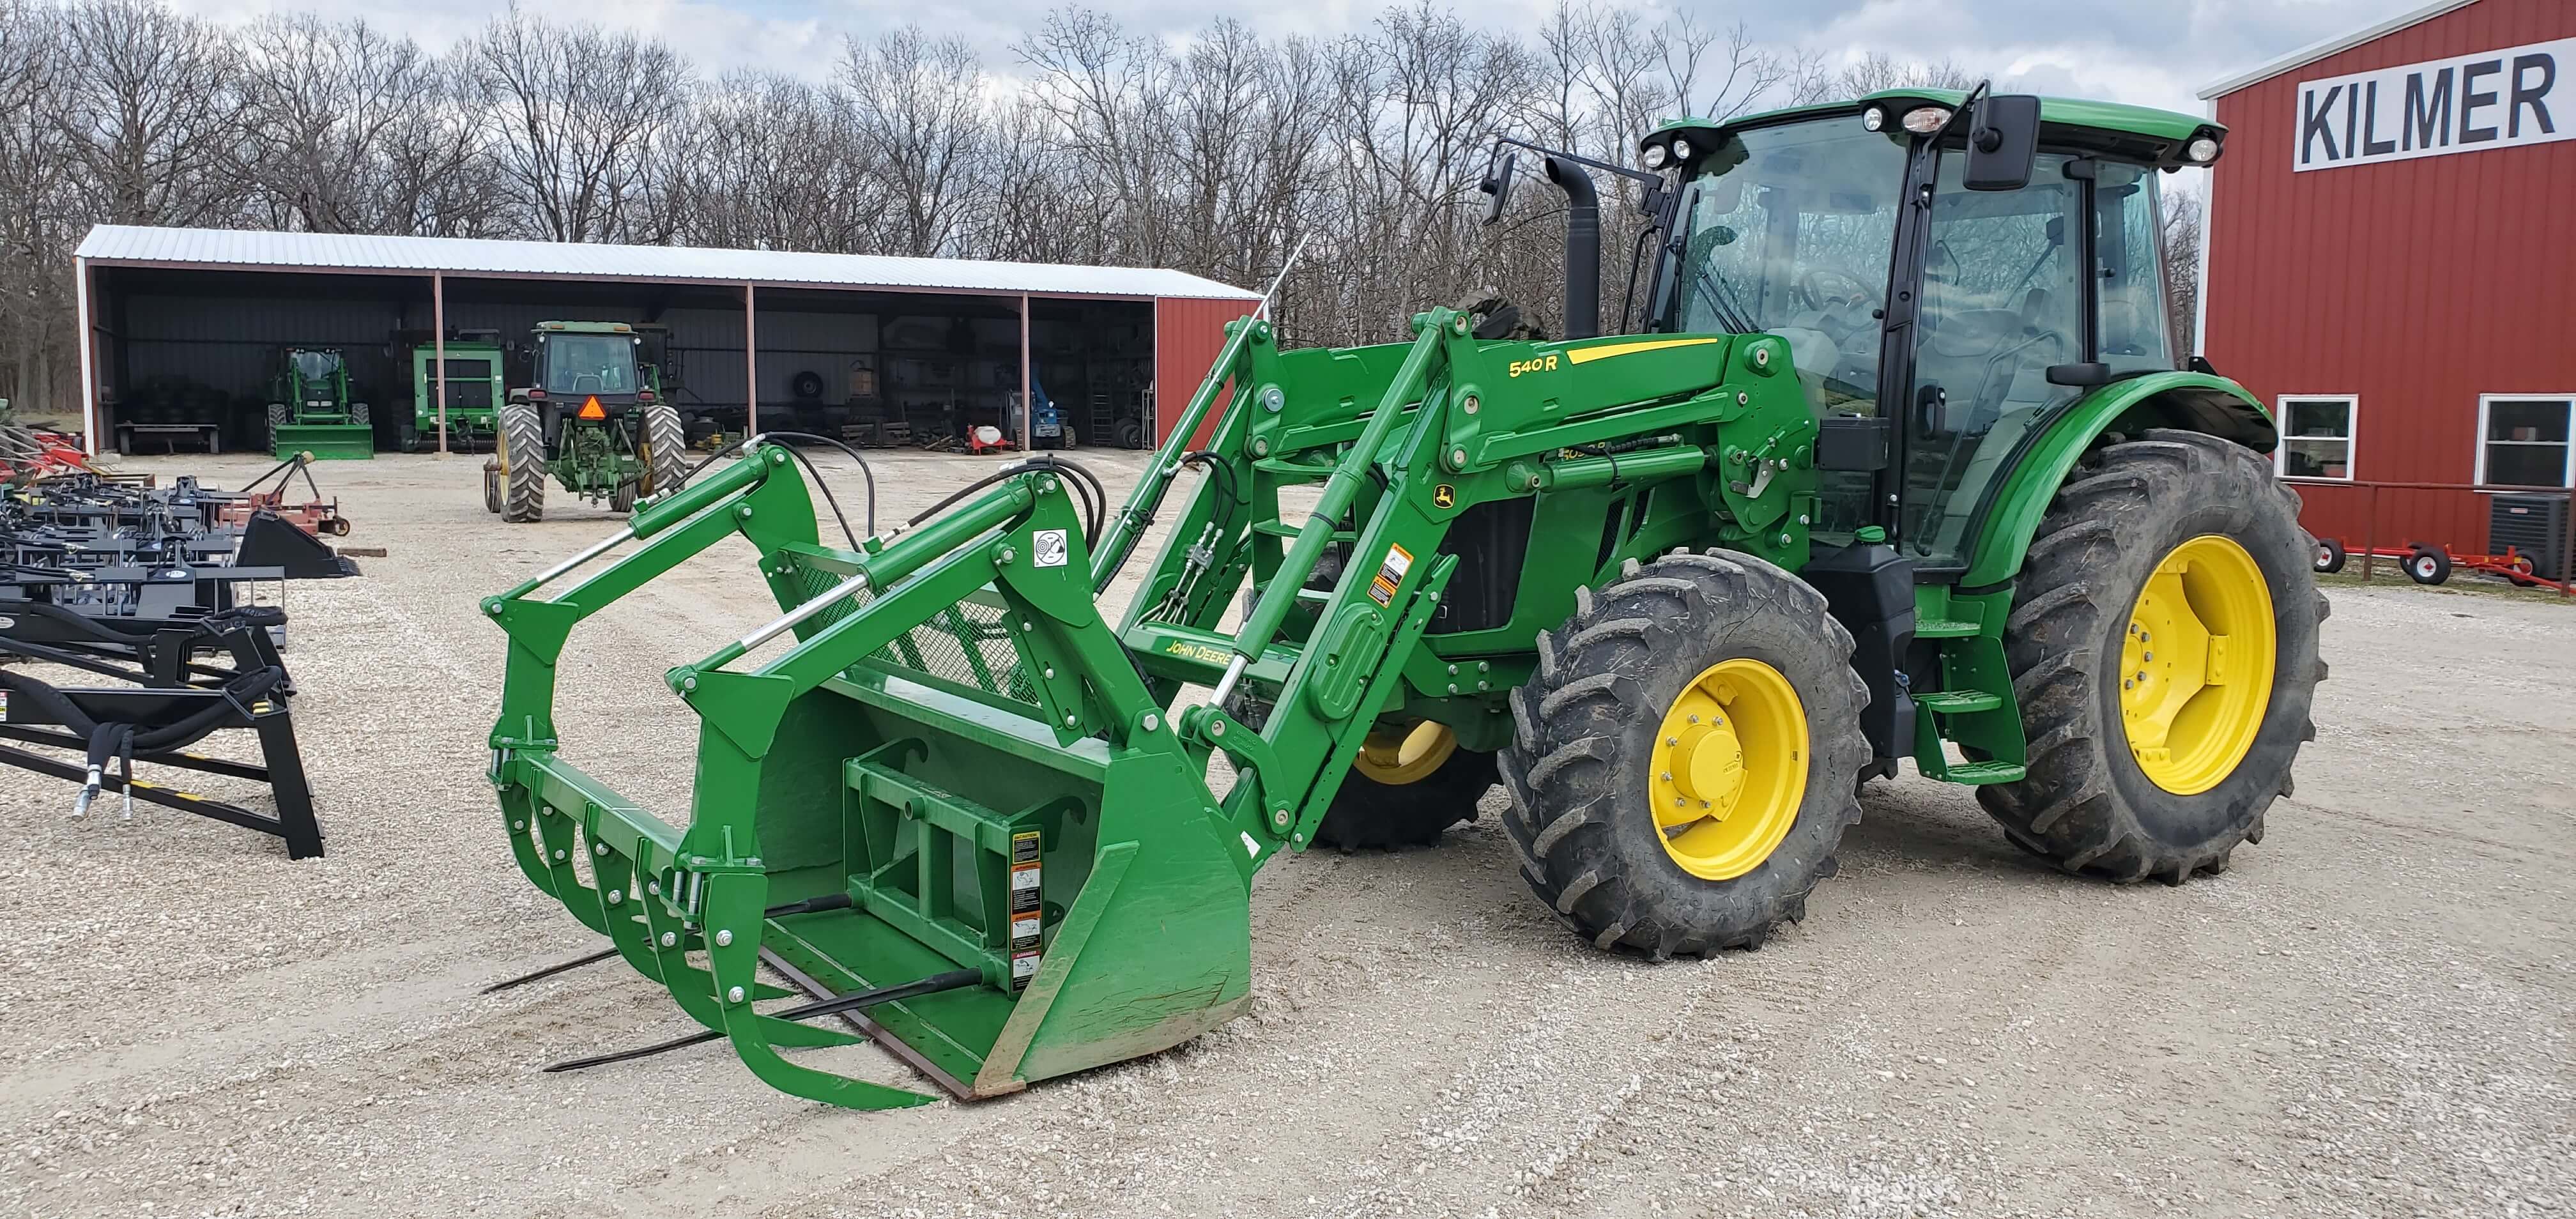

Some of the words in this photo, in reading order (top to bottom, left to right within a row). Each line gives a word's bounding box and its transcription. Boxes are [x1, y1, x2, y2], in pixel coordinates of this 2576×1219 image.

[2301, 52, 2556, 164] KILMER
[1166, 640, 1197, 657] JOHN
[1195, 646, 1233, 665] DEERE
